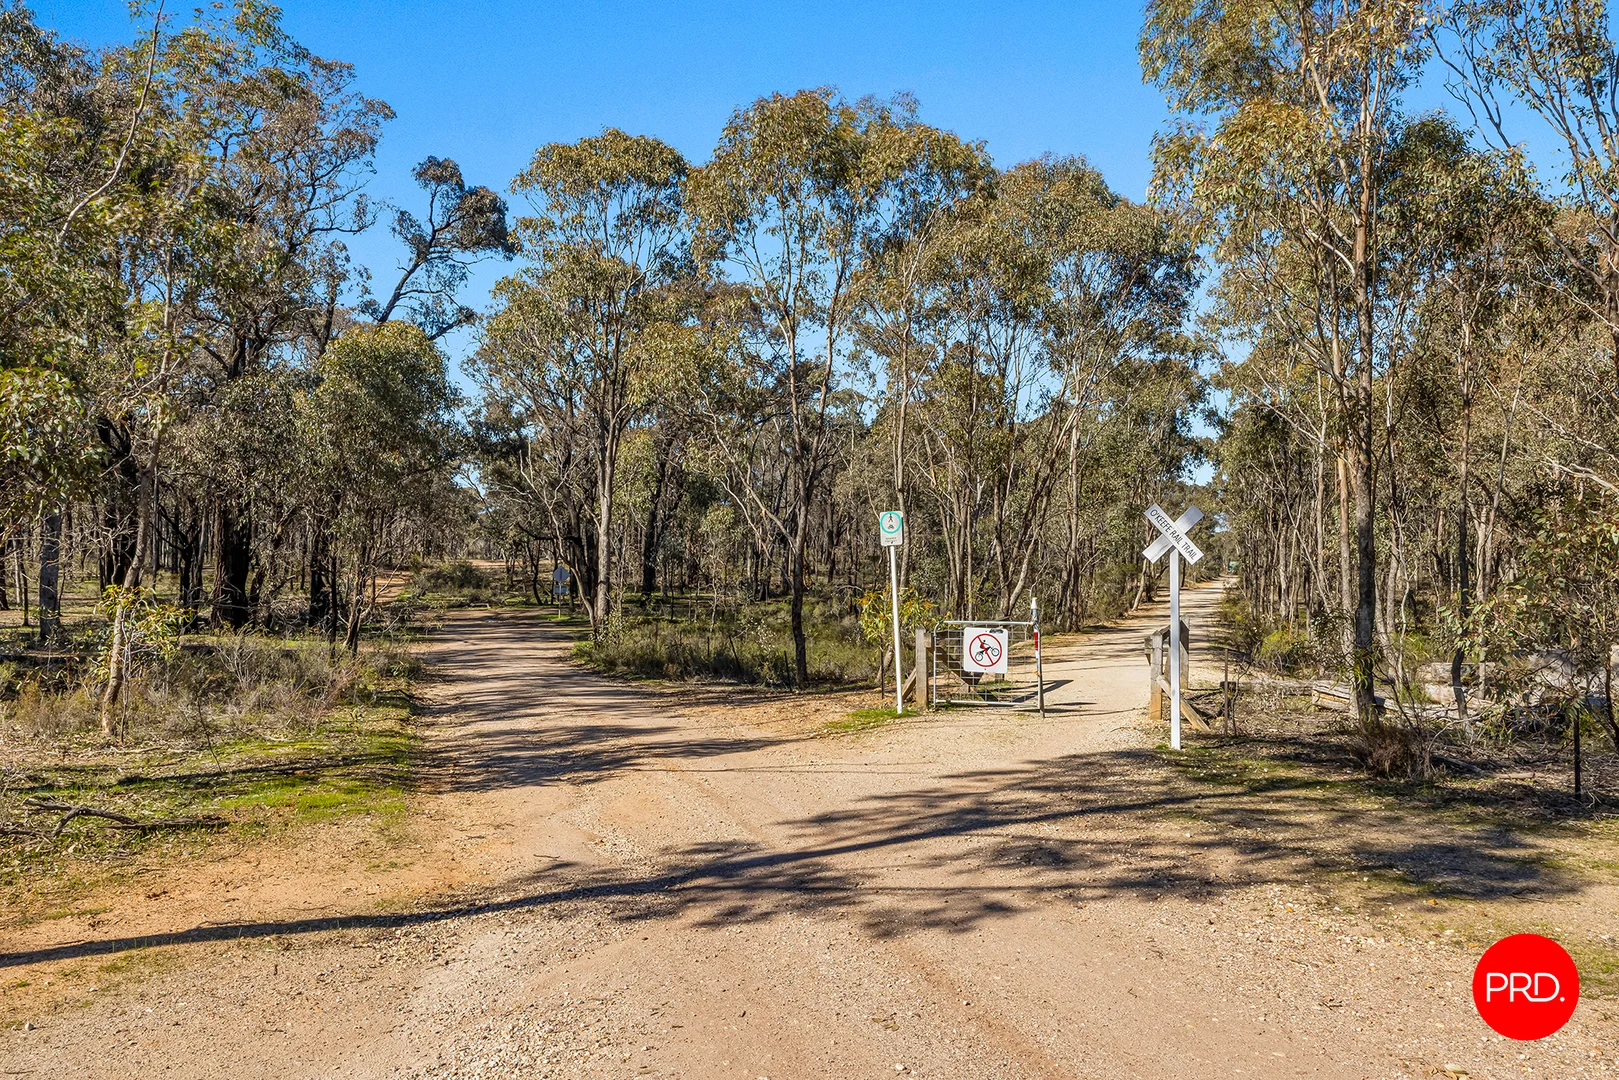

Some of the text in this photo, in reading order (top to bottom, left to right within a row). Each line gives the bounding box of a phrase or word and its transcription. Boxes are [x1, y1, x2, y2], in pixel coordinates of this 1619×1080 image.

[1150, 508, 1197, 560] O'KEEFE RAIL TRAIL
